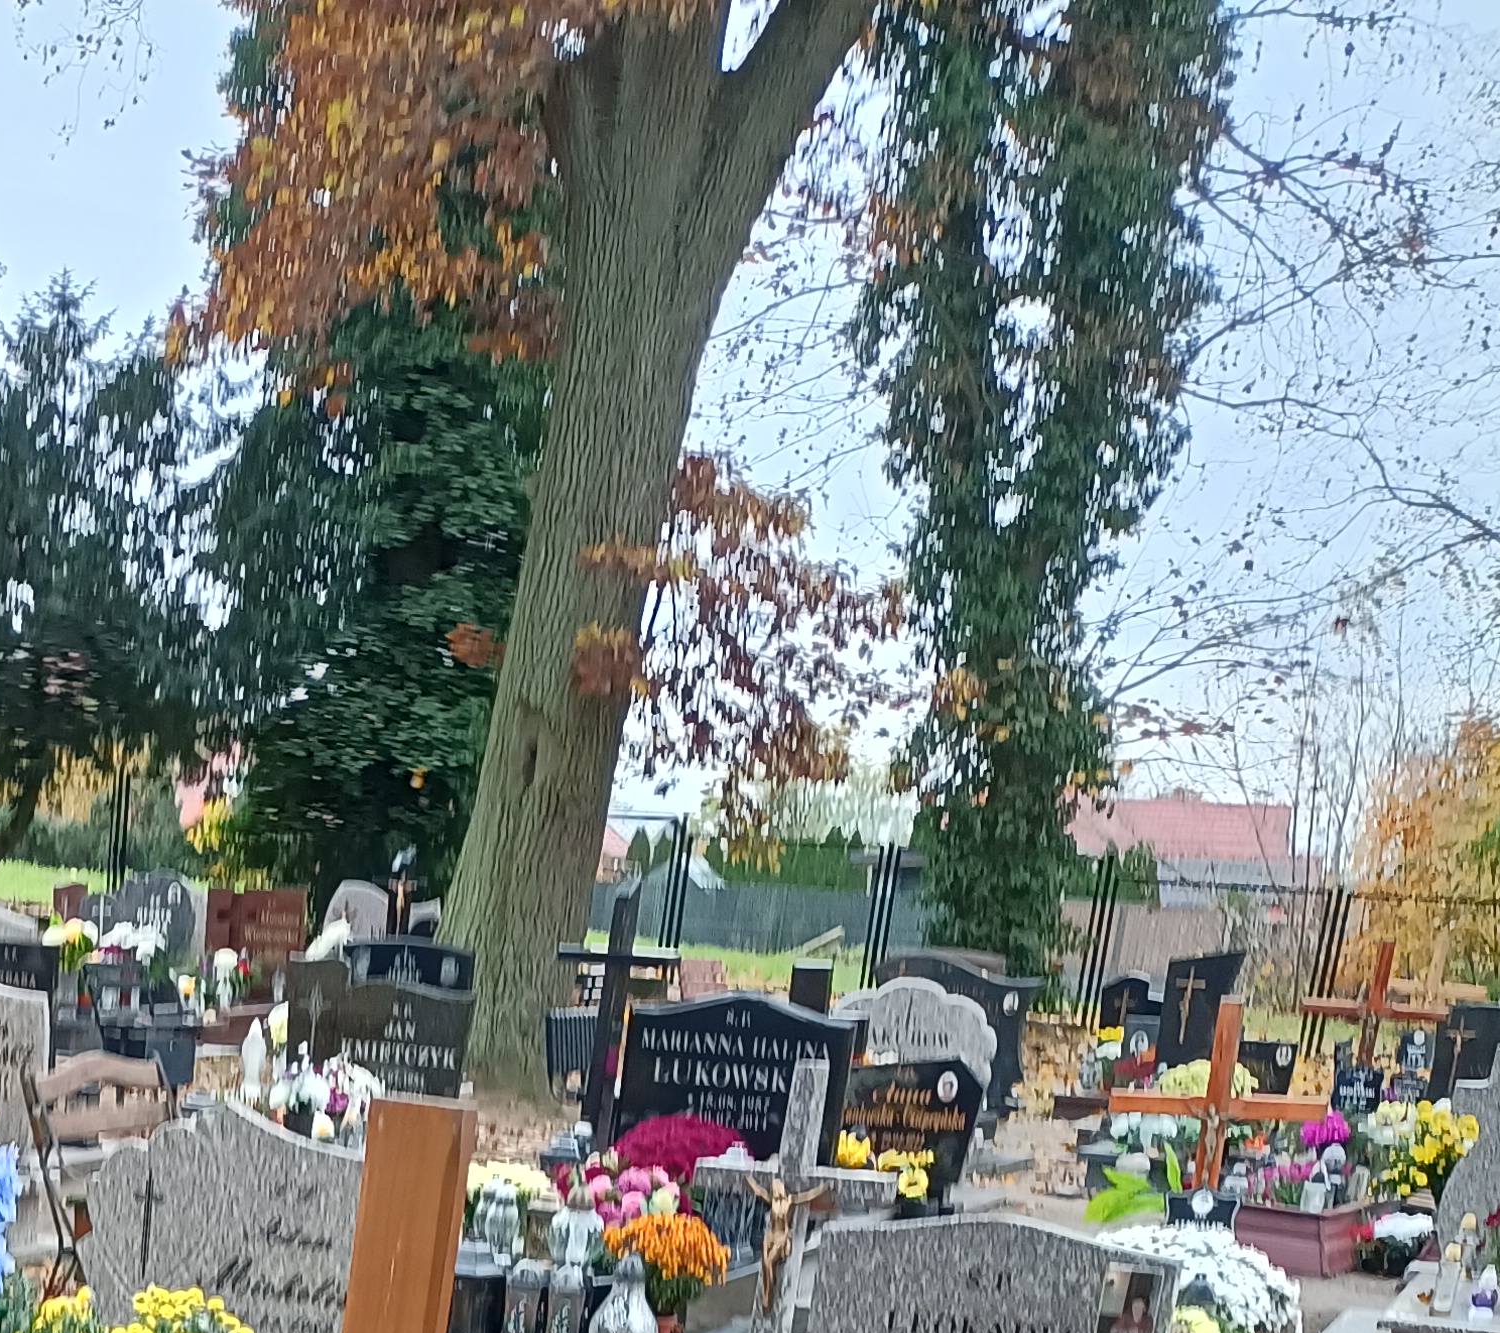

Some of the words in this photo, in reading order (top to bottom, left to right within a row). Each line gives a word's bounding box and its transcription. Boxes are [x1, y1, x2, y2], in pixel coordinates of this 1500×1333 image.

[384, 1018, 416, 1041] JAN
[641, 1027, 744, 1057] MARIANNA
[752, 1035, 829, 1060] HALINA
[653, 1056, 787, 1094] ŁUKOWSK
